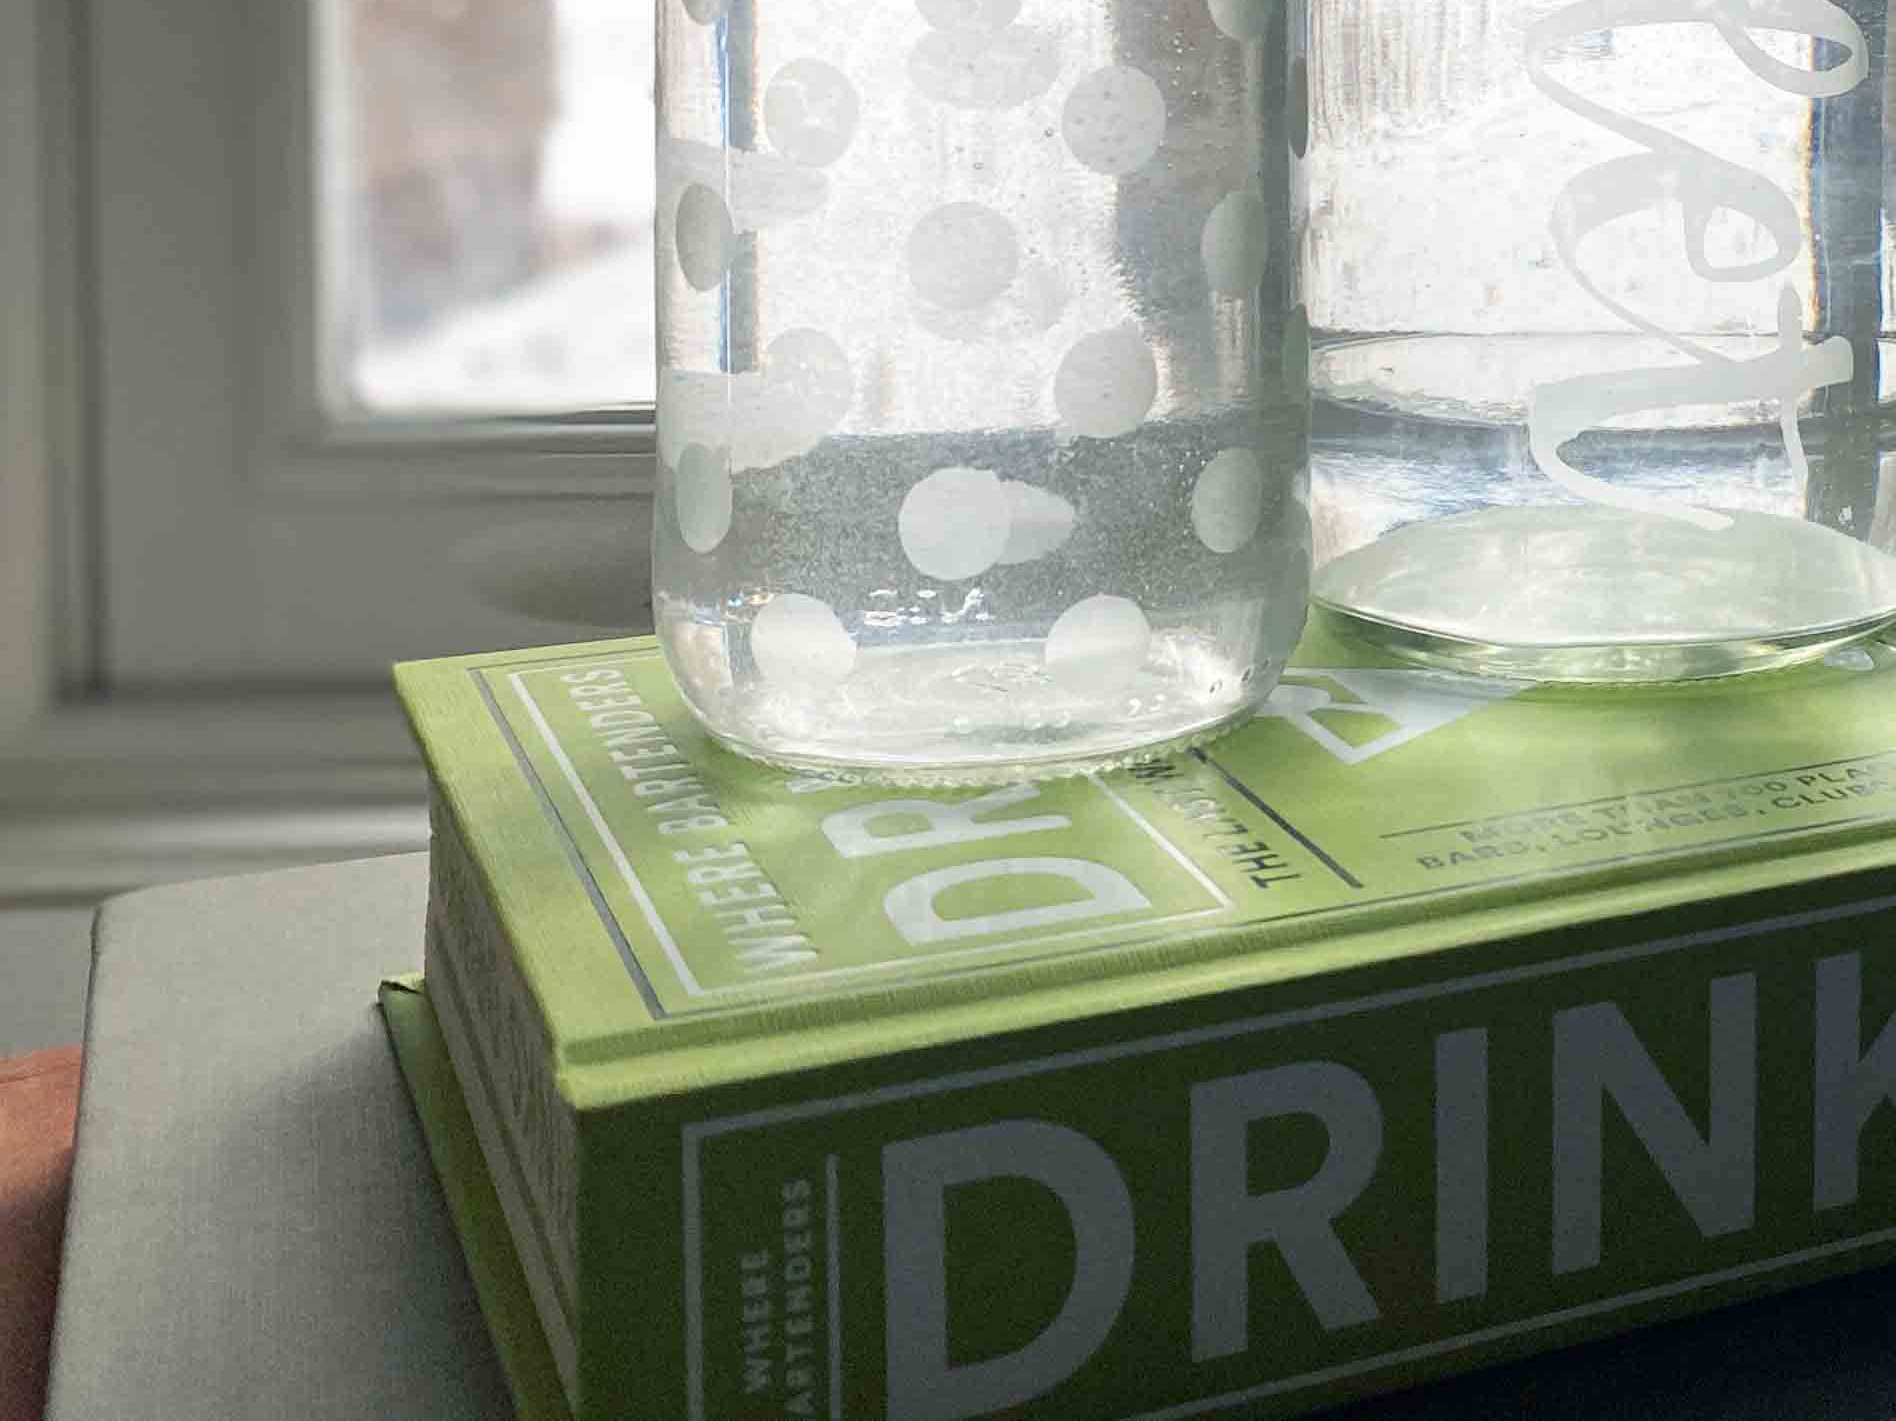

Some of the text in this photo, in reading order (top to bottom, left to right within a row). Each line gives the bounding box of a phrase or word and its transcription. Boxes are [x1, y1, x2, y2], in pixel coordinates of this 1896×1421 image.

[559, 668, 819, 975] WHERE BARTENDERS
[739, 1248, 770, 1395] WHERE
[781, 1178, 815, 1421] ARTENDERS
